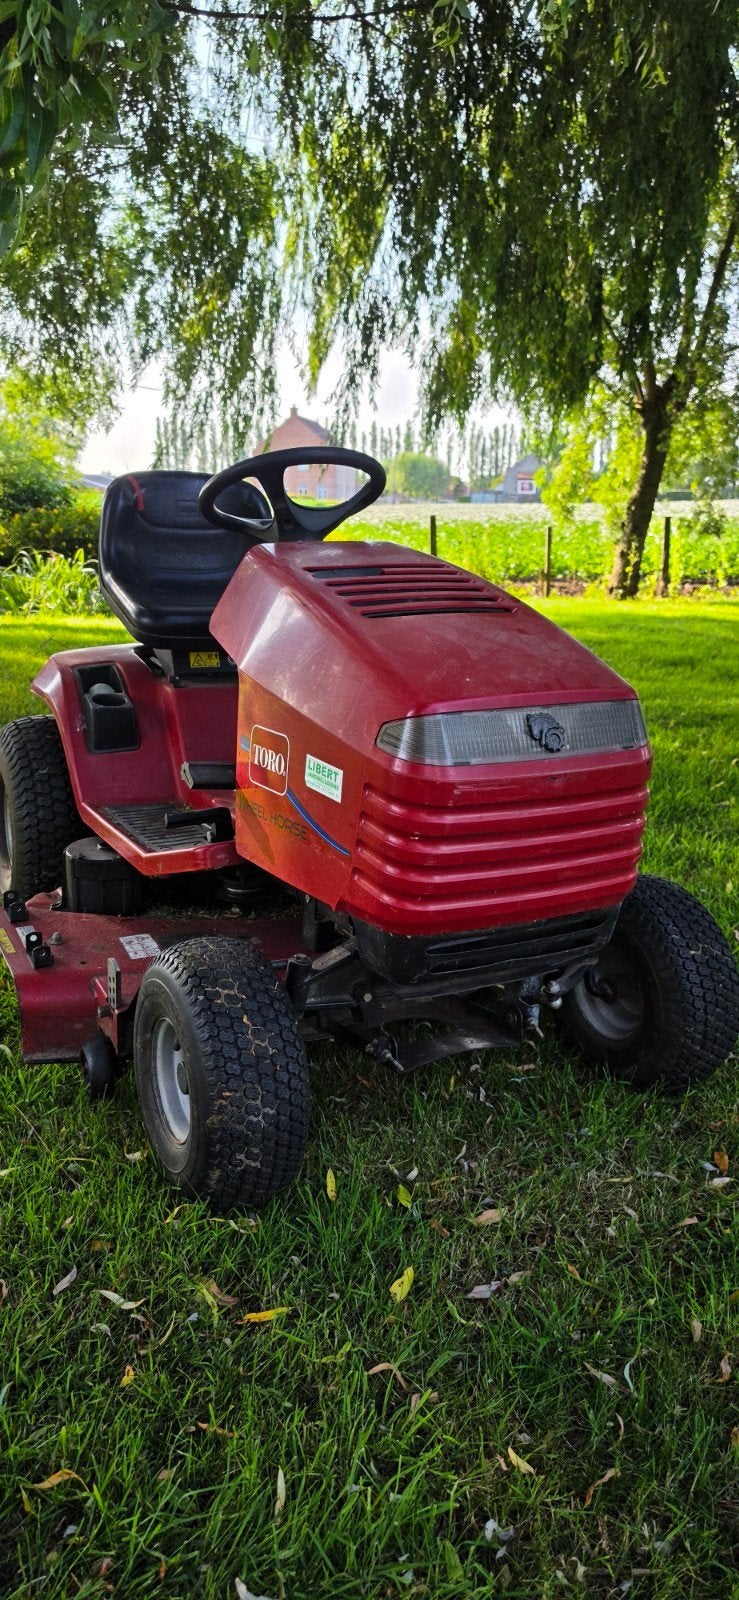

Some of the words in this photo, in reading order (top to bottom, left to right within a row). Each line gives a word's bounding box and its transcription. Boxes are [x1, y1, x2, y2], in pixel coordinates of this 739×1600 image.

[253, 744, 285, 774] TORO
[307, 759, 339, 783] LIBERT
[269, 812, 307, 841] HORSE
